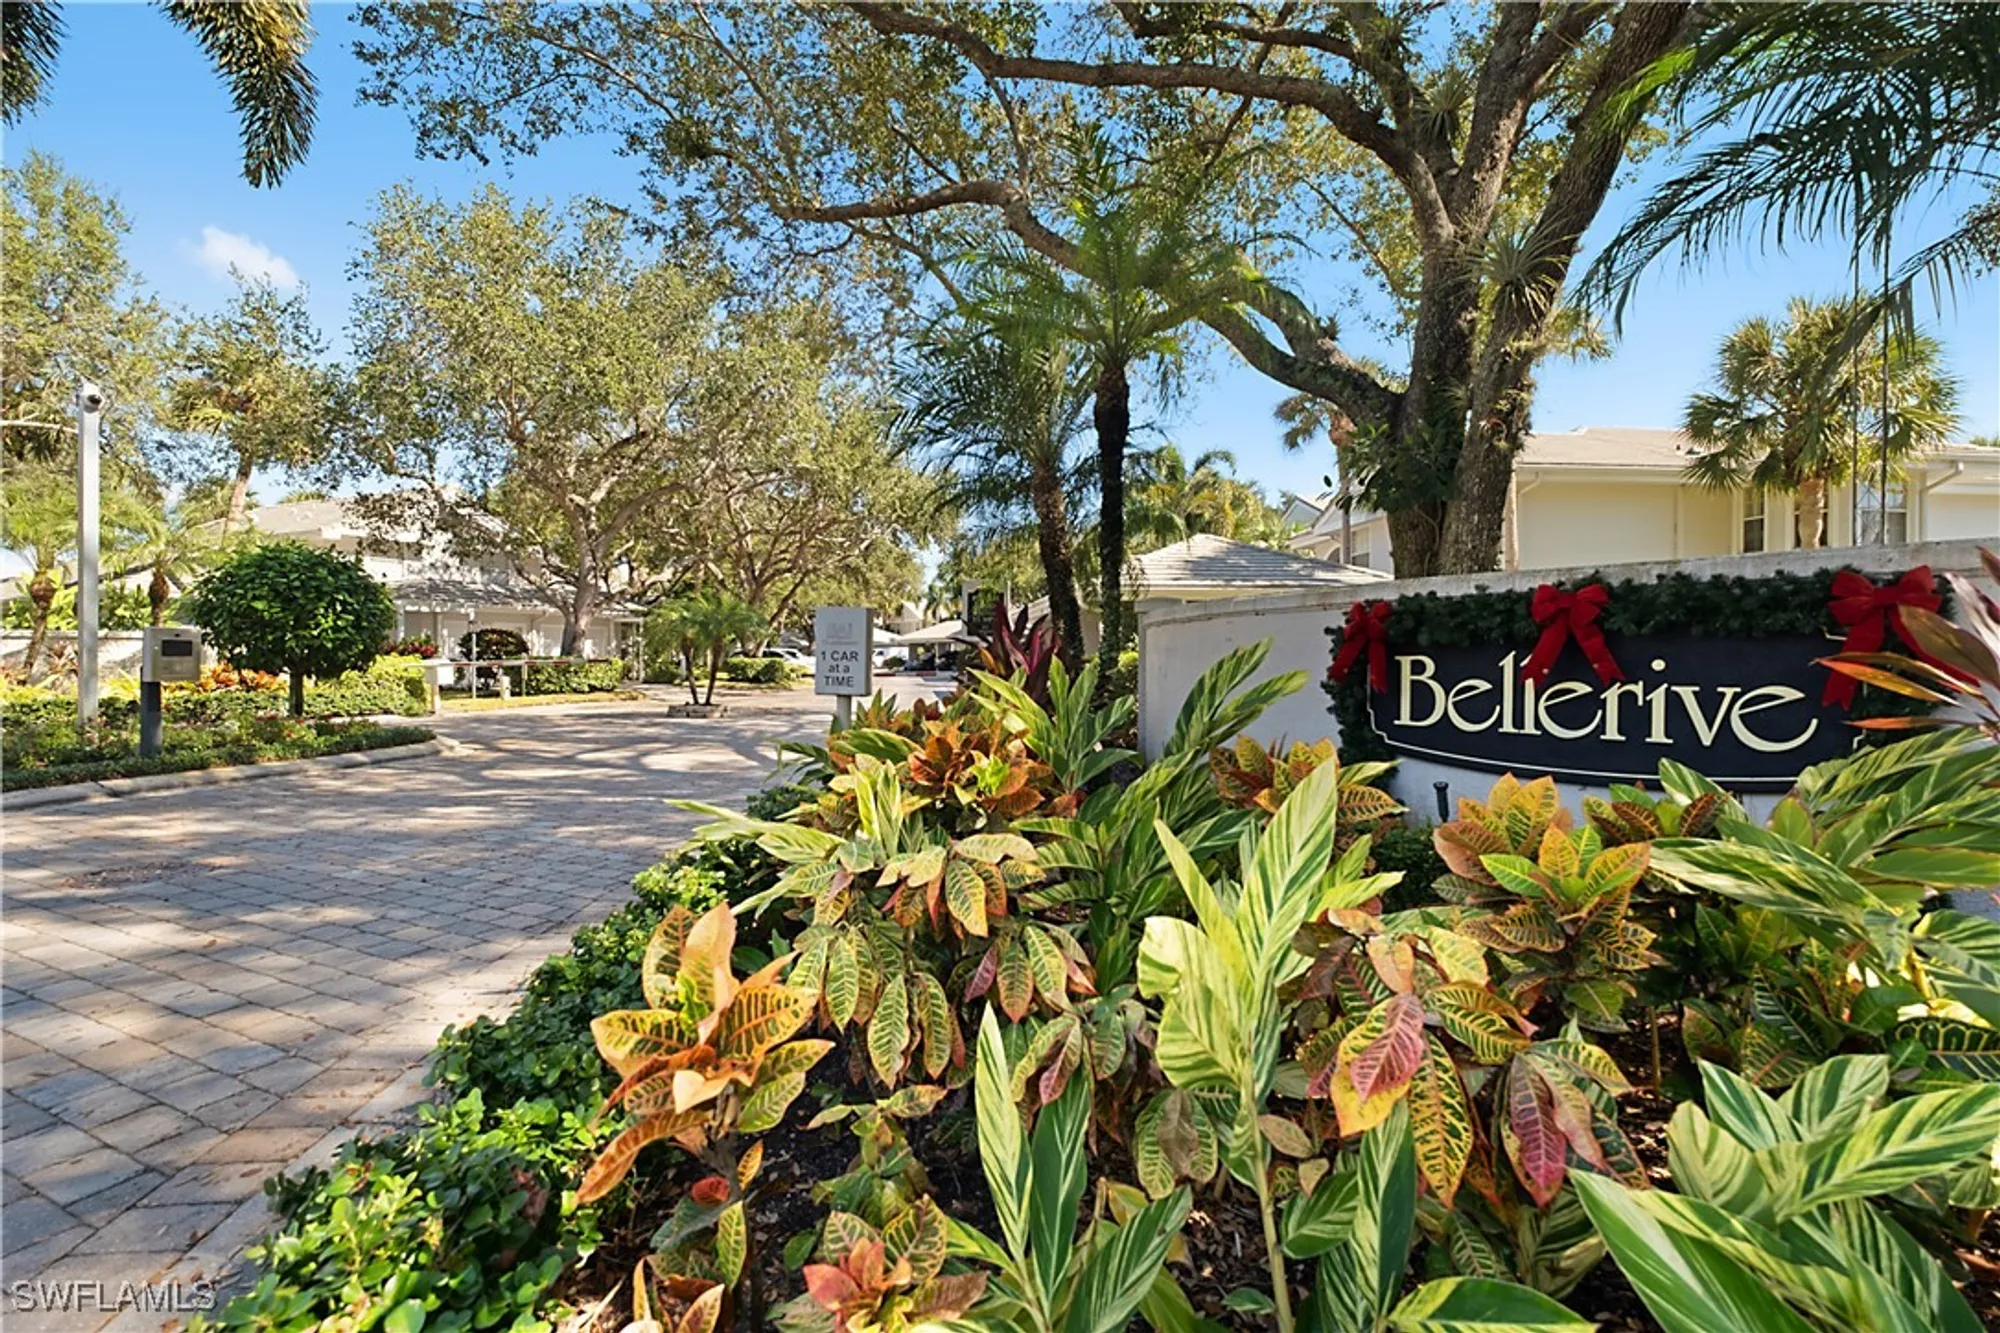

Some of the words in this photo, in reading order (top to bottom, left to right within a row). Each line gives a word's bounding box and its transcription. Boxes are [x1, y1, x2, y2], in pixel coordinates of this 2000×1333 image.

[821, 650, 827, 661] 1
[830, 650, 859, 662] CAR
[828, 663, 840, 674] at
[843, 665, 850, 674] a
[824, 675, 854, 688] TIME
[1394, 650, 1819, 753] Bellerive
